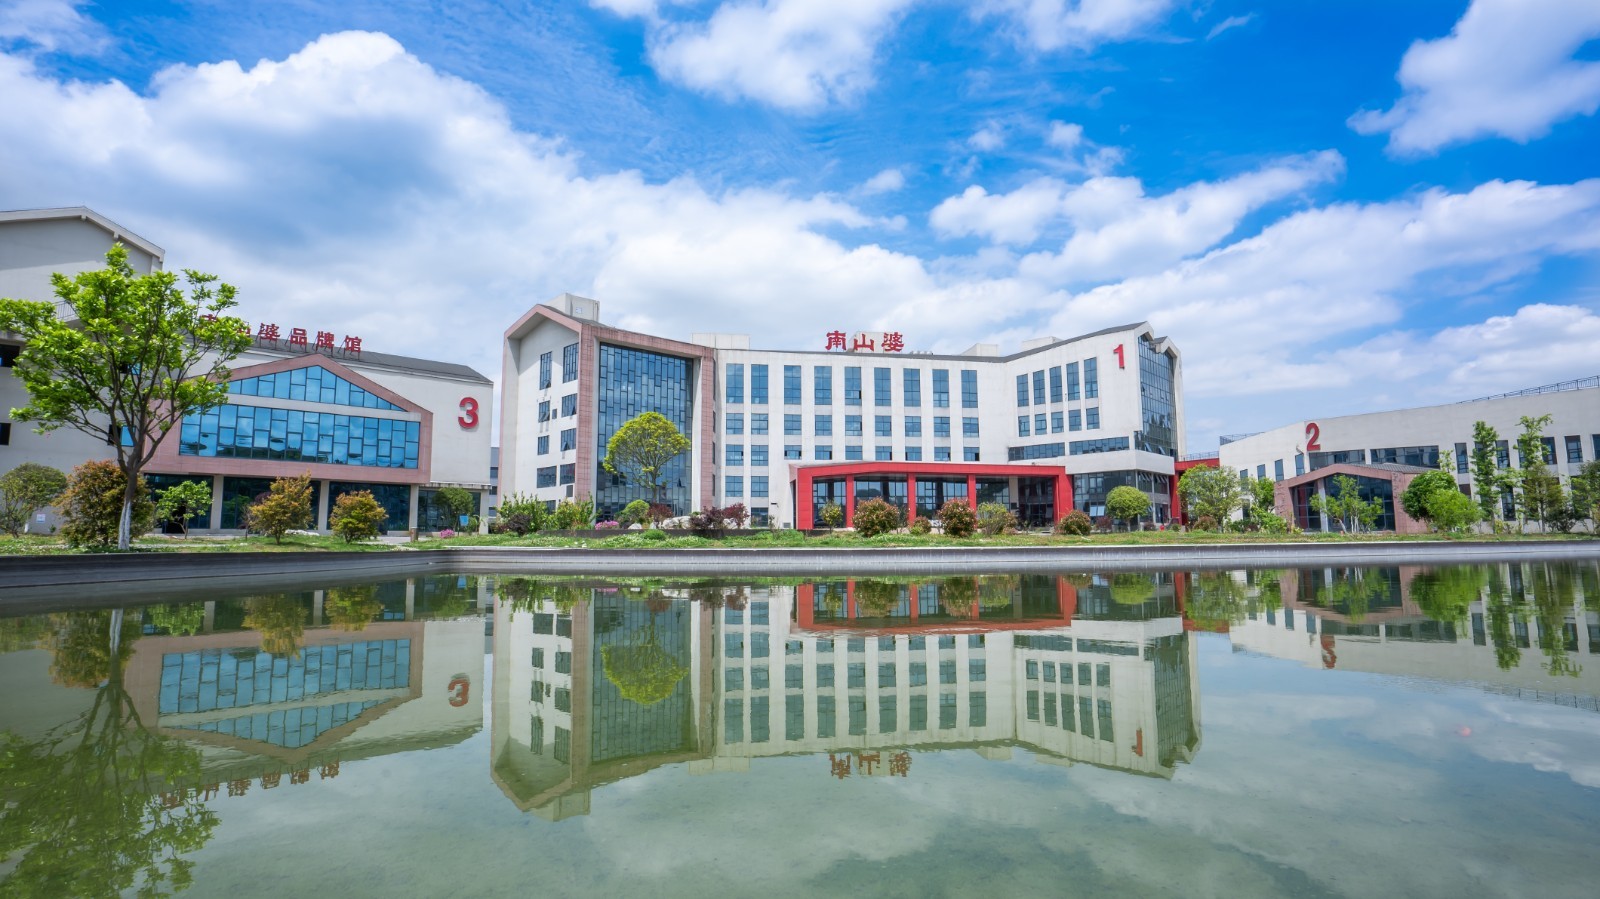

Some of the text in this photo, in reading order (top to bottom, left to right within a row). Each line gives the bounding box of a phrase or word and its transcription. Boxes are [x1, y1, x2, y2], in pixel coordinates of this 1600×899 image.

[200, 314, 362, 353] 婆品牌馆
[825, 330, 904, 352] 南山婆
[1113, 344, 1125, 370] 1
[458, 397, 479, 430] 3
[1305, 422, 1321, 451] 2
